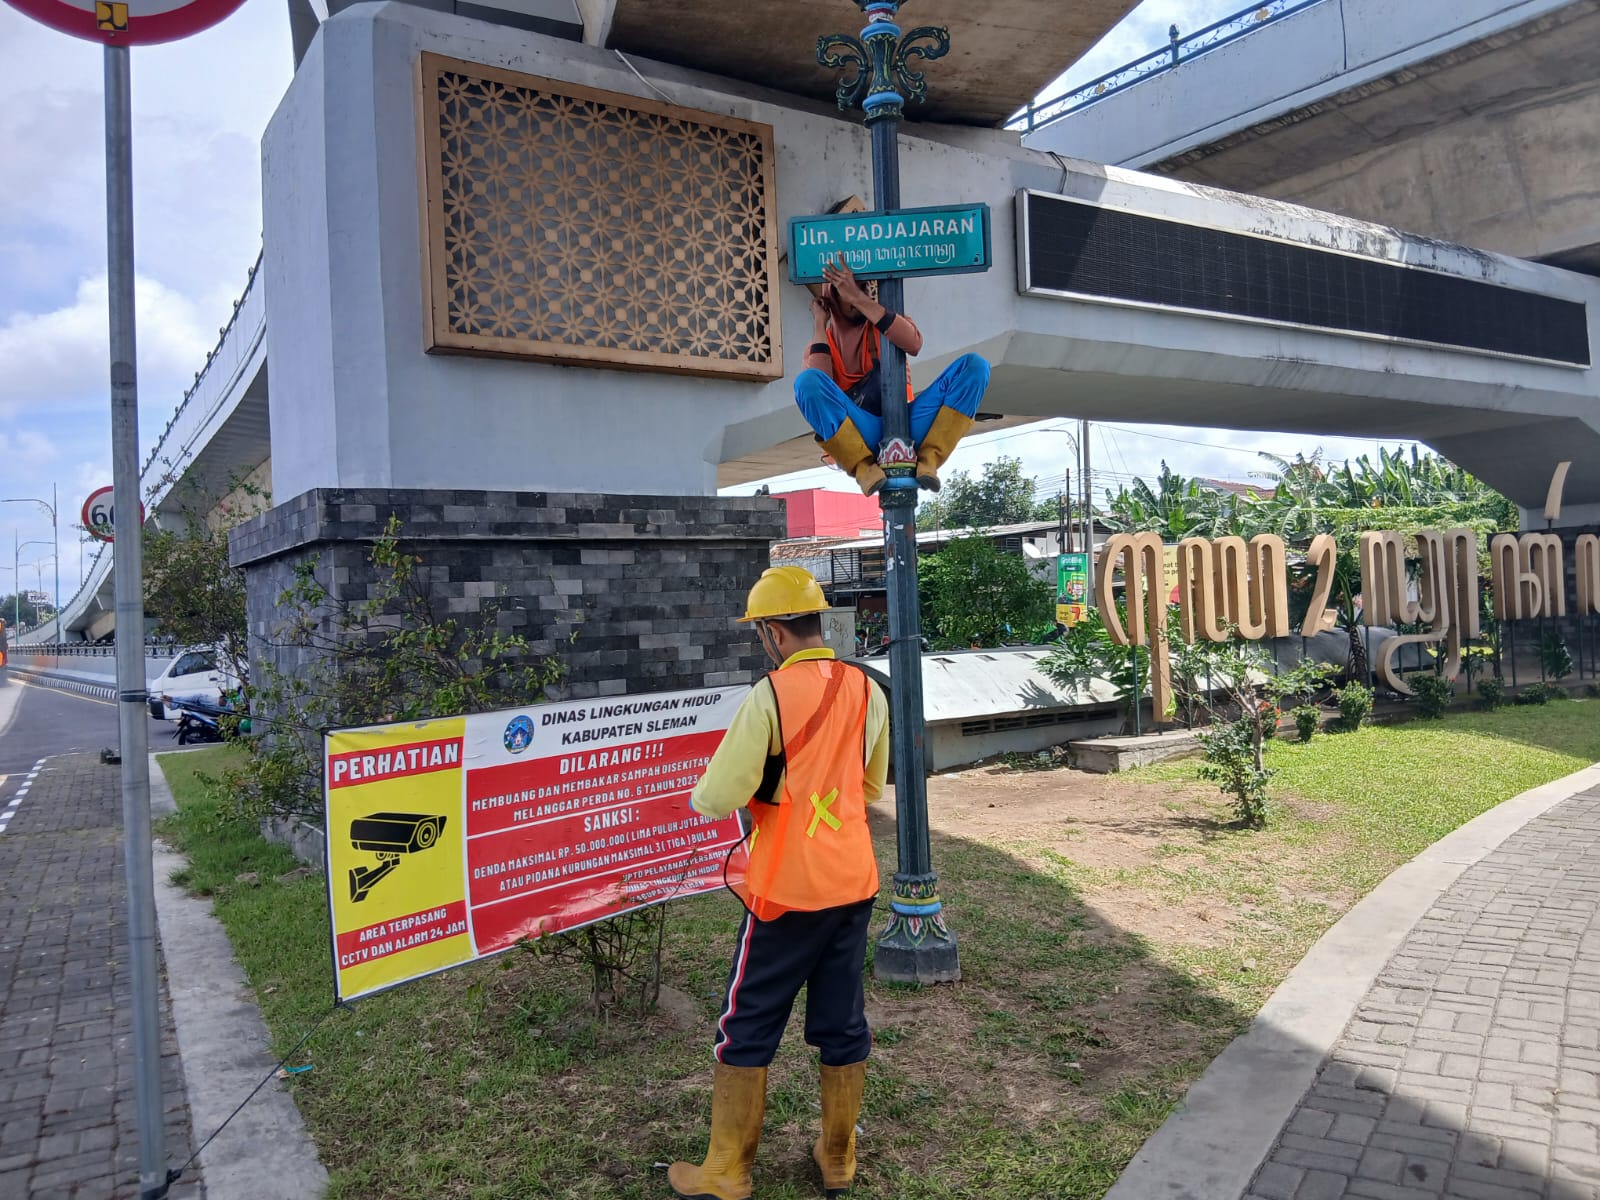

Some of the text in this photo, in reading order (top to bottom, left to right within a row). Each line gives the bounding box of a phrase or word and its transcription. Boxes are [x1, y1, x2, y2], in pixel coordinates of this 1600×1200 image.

[800, 218, 974, 246] Jln. PADJAJARAN
[541, 693, 722, 727] DINAS LINGKUNGAN HIDUP
[561, 715, 697, 746] KABUPATEN SLEMAN
[333, 743, 459, 782] PERHATIAN
[559, 746, 641, 775] DILARANG
[472, 756, 709, 812] MEMBUANG DAN MEMBAKAR SAMPAH DISEKITAR
[513, 800, 580, 822] MELANGGAR
[581, 793, 614, 808] PERDA
[636, 786, 642, 796] 6
[643, 779, 675, 794] TAHUN
[677, 774, 698, 788] 2023
[474, 861, 507, 880] DENDA
[508, 850, 557, 871] MAKSIMAL
[652, 822, 678, 837] PULUH
[679, 818, 699, 832] JUTA
[499, 877, 525, 892] ATAU
[527, 869, 560, 888] PIDANA
[562, 856, 610, 876] KURUNGAN
[610, 846, 655, 865] MAKSIMAL
[691, 829, 718, 846] BULAN
[698, 863, 720, 876] HIDUP
[341, 920, 466, 966] CCTV DAN ALARM 24 JAM
[359, 907, 447, 943] AREA TERPASANG
